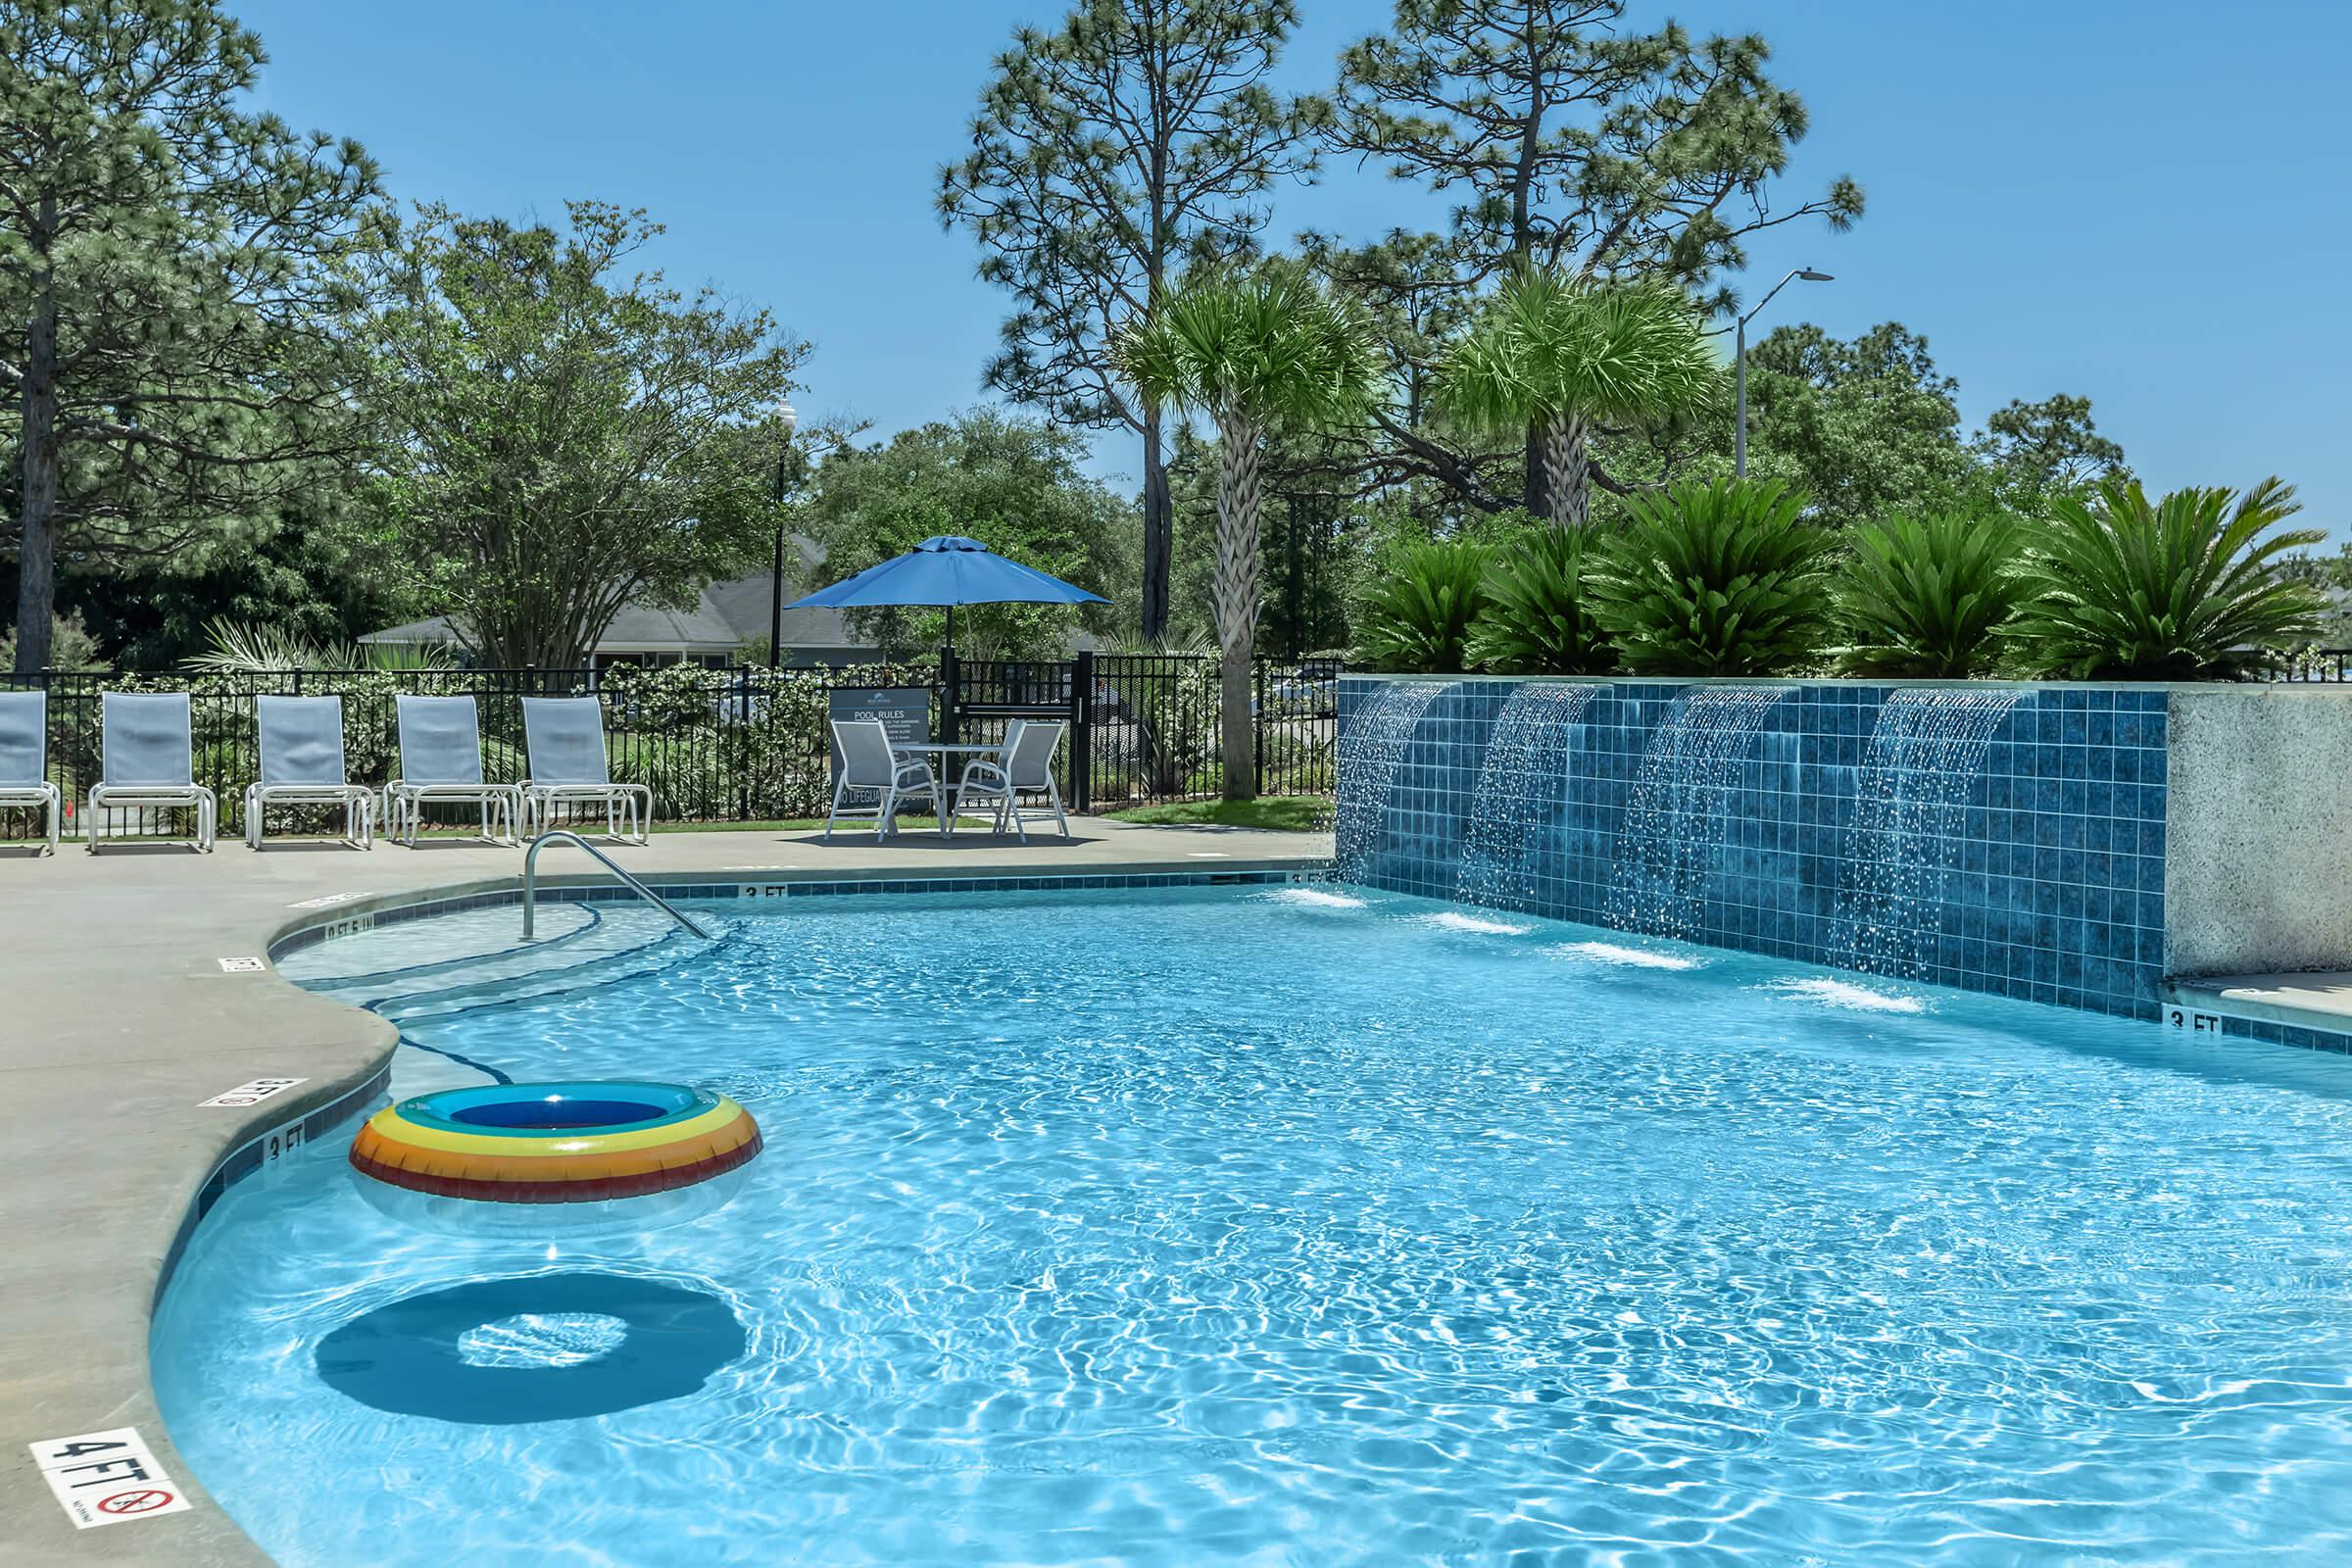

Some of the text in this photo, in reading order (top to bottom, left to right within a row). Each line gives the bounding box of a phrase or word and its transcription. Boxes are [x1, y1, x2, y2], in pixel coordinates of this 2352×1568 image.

[855, 711, 875, 720] POOL
[878, 710, 905, 720] RULES
[850, 789, 882, 804] LIFEGUA
[746, 885, 786, 897] 3 FT
[2171, 1010, 2219, 1033] 3 FT
[270, 1123, 303, 1160] 3 FT
[53, 1442, 150, 1489] 4 FT
